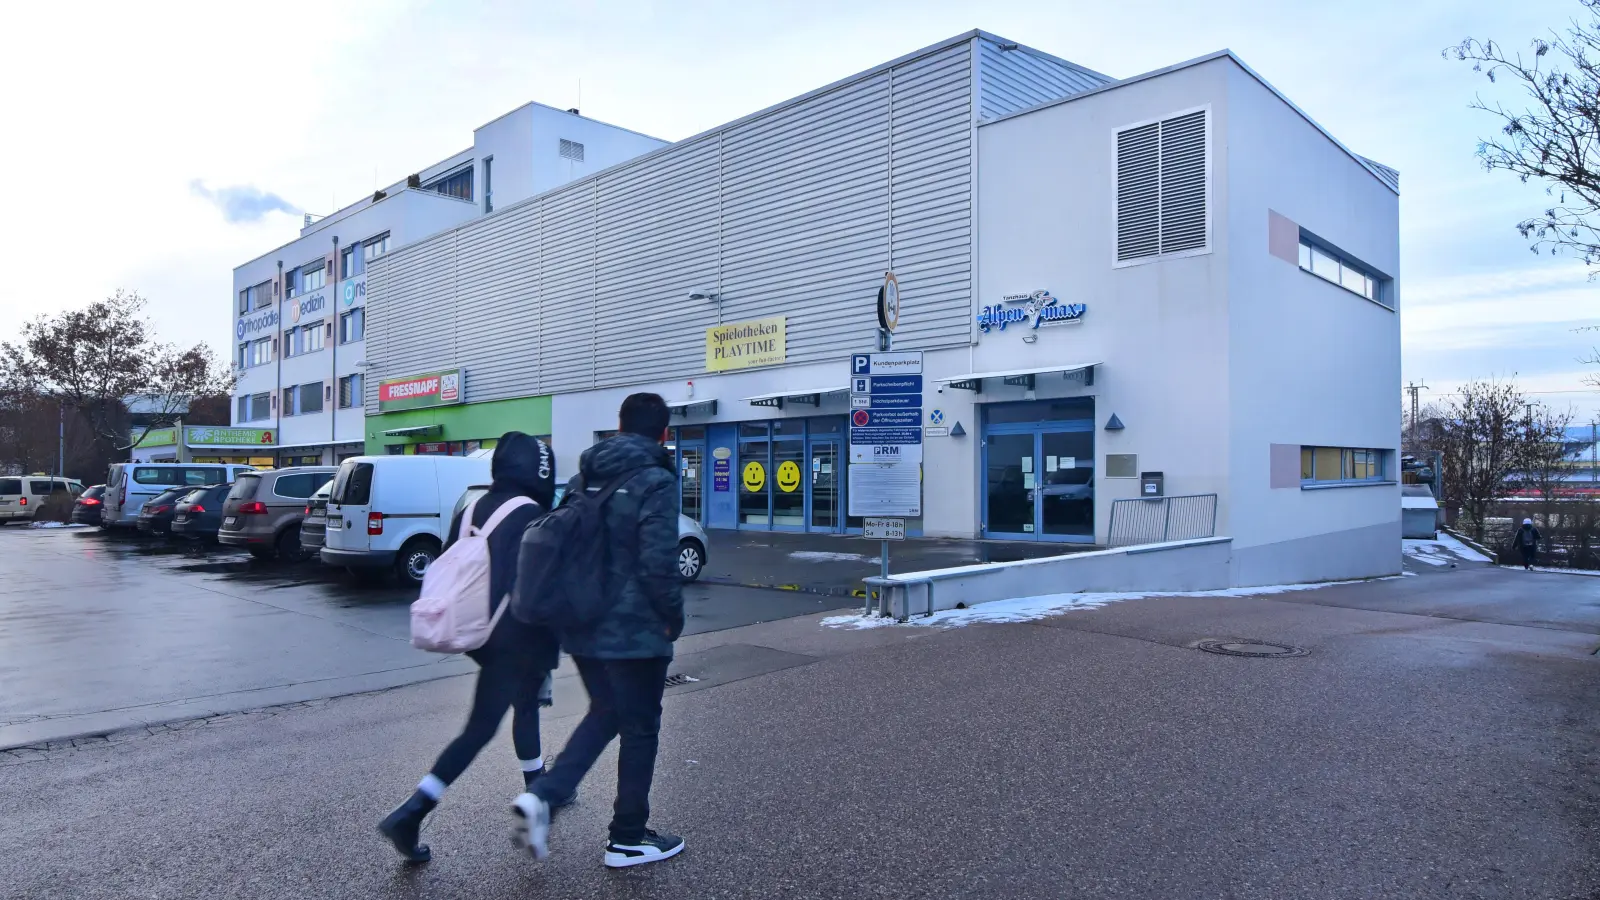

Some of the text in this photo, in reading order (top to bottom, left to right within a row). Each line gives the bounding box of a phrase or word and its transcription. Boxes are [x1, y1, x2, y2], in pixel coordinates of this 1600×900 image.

[979, 303, 1080, 332] Alpen max
[713, 323, 778, 345] Spielotheken
[714, 339, 776, 360] PLAYTIME
[855, 356, 867, 372] P
[389, 378, 438, 398] FRESSNAPF
[214, 429, 256, 437] ANTHEMIS
[214, 436, 256, 444] APOTHEKE
